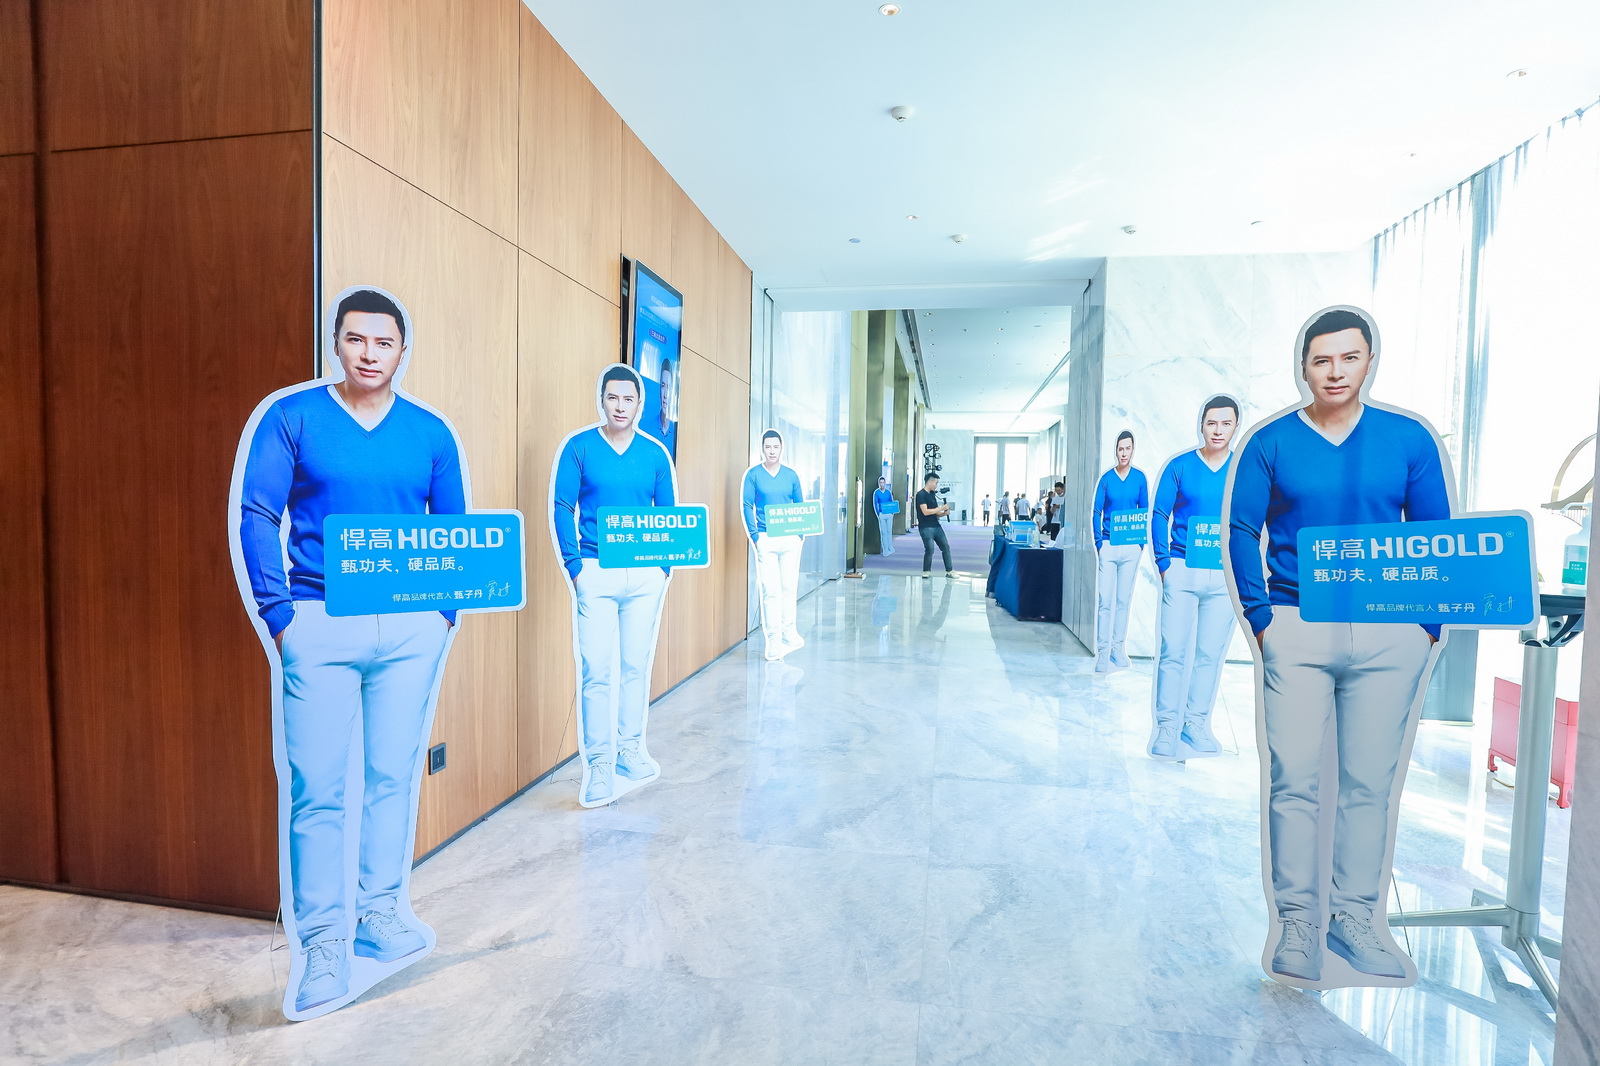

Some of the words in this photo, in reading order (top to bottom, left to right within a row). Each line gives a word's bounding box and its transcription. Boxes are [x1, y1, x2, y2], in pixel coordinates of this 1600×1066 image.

[605, 514, 635, 529] 悍高
[340, 527, 393, 551] 悍高
[1312, 537, 1366, 561] 悍高
[392, 591, 453, 603] 悍高品牌代言人
[454, 589, 483, 600] 甄子丹
[1365, 602, 1435, 613] 悍高品牌代言人
[1437, 602, 1476, 614] 甄子丹
